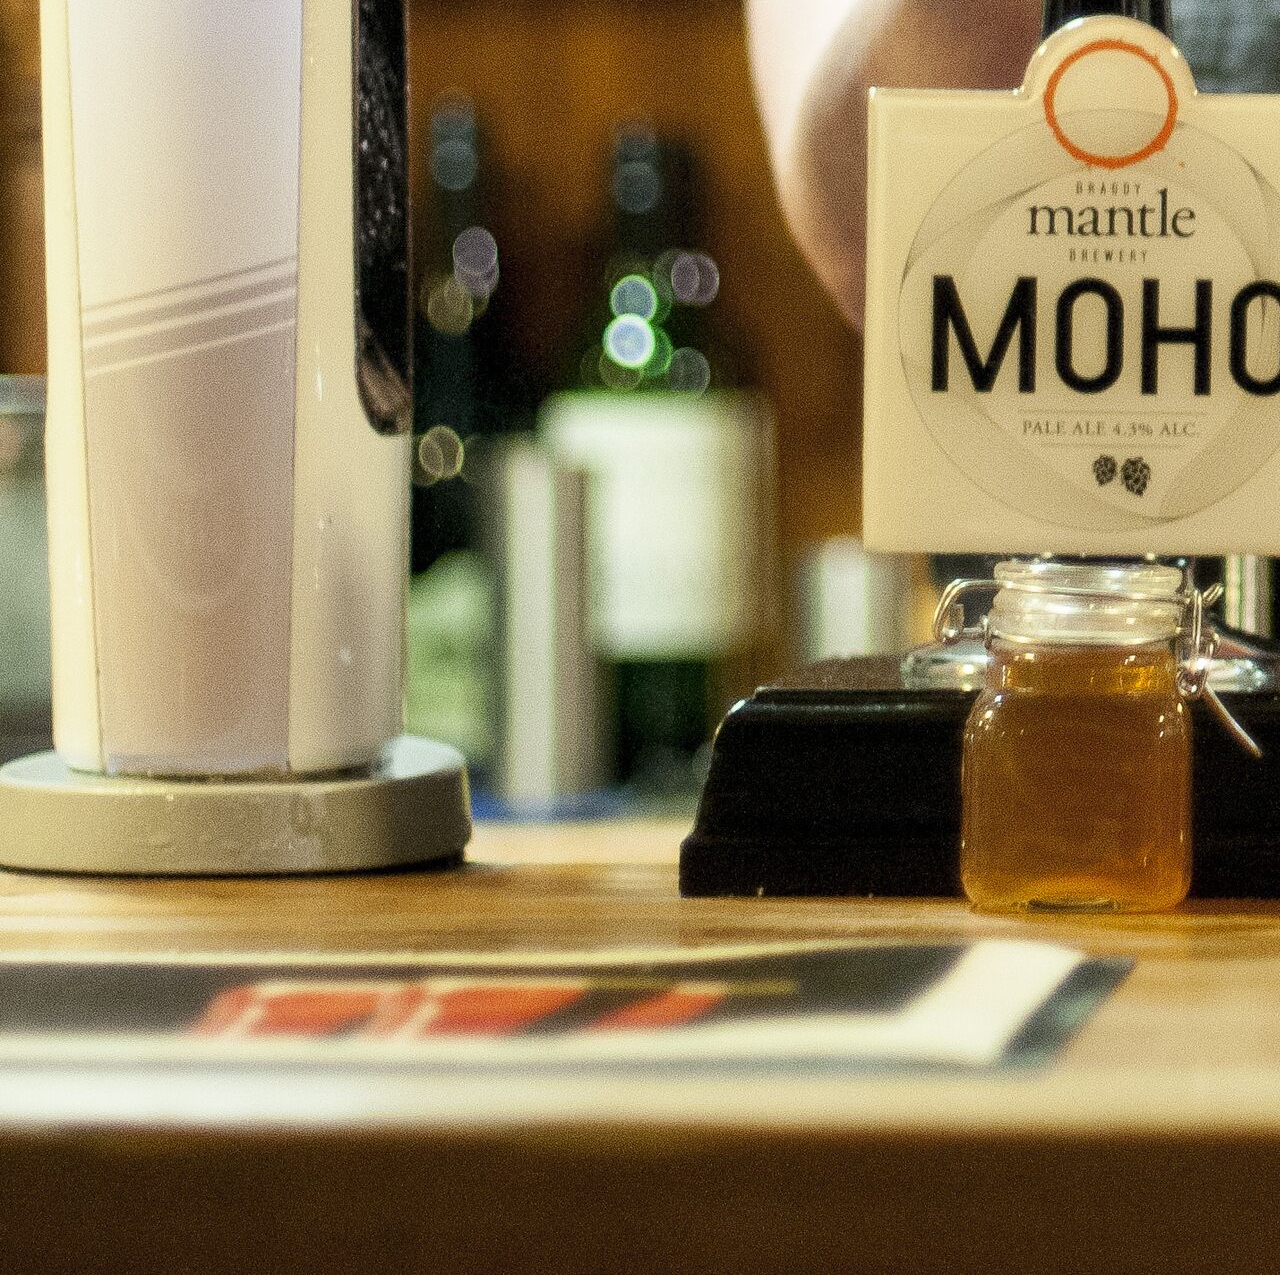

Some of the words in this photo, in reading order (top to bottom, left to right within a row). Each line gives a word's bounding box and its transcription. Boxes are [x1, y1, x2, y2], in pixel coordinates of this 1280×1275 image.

[1027, 187, 1197, 239] mantle
[1069, 248, 1148, 264] BREWERY
[1022, 419, 1065, 436] PALE
[1072, 419, 1106, 436] ALE
